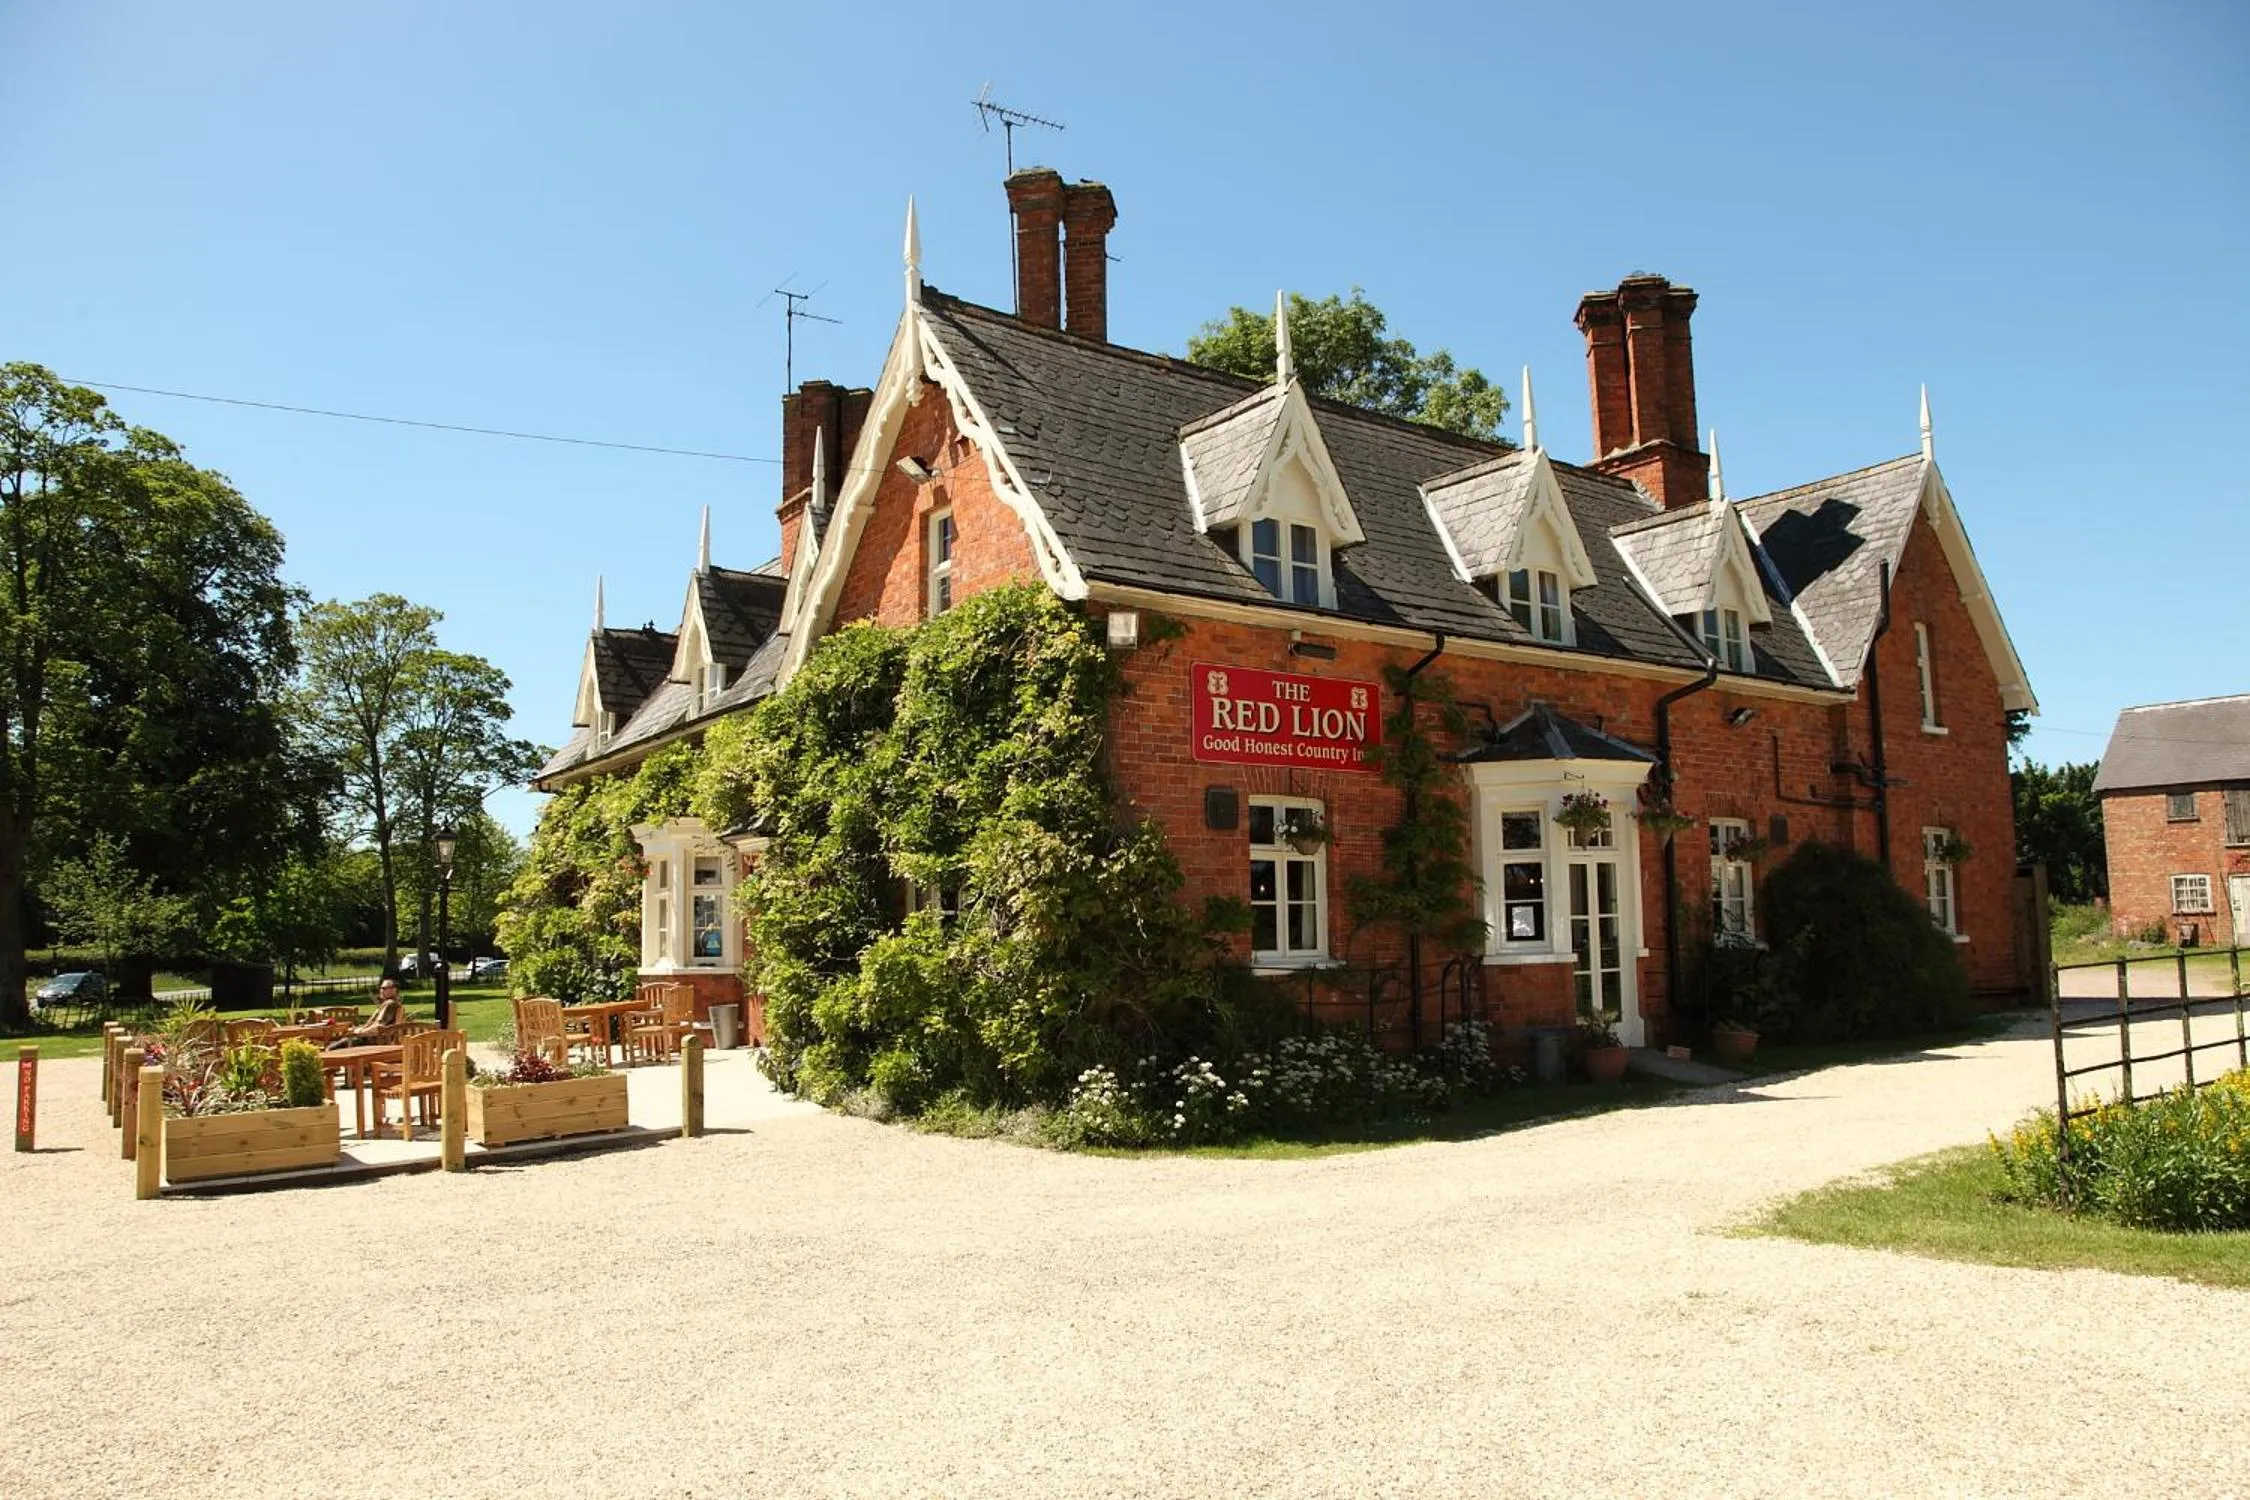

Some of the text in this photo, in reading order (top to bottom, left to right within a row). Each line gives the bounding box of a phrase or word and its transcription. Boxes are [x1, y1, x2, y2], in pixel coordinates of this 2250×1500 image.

[1272, 680, 1311, 703] THE
[1211, 696, 1366, 743] RED LION
[1203, 734, 1368, 765] Good Honest Country In
